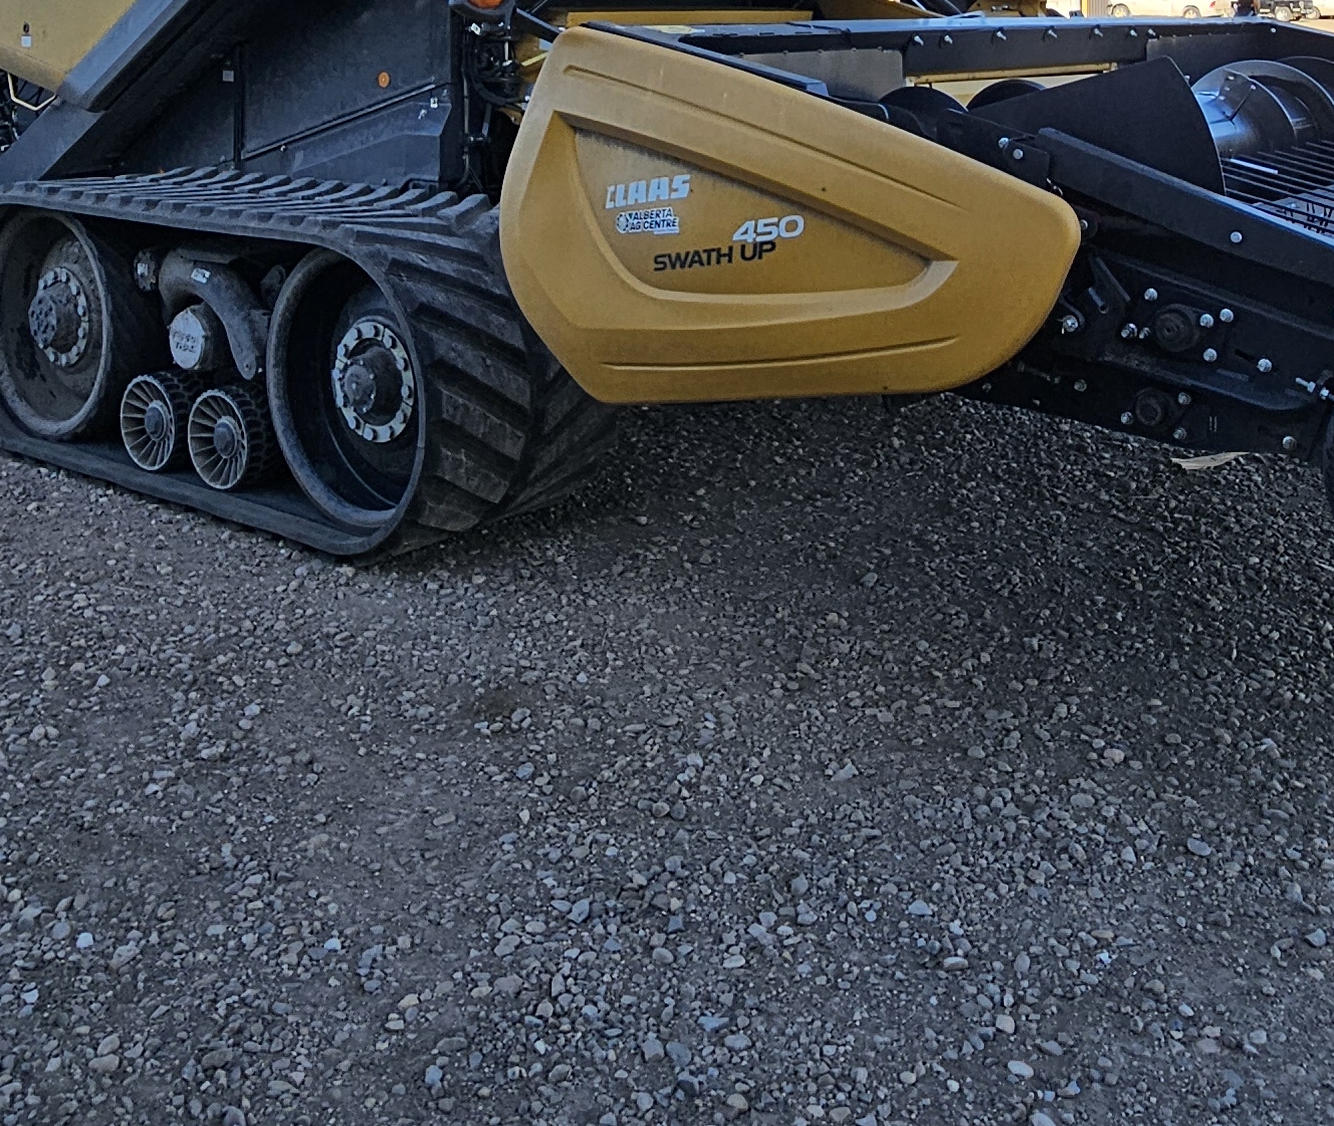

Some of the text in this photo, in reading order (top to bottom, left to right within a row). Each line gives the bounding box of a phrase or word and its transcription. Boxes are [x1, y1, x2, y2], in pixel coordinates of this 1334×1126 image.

[604, 174, 691, 209] CLAAS
[630, 221, 641, 231] AG
[643, 218, 677, 230] CENTRE
[633, 208, 673, 220] ALBERTA
[732, 214, 805, 243] 450
[653, 240, 776, 272] SWATH UP
